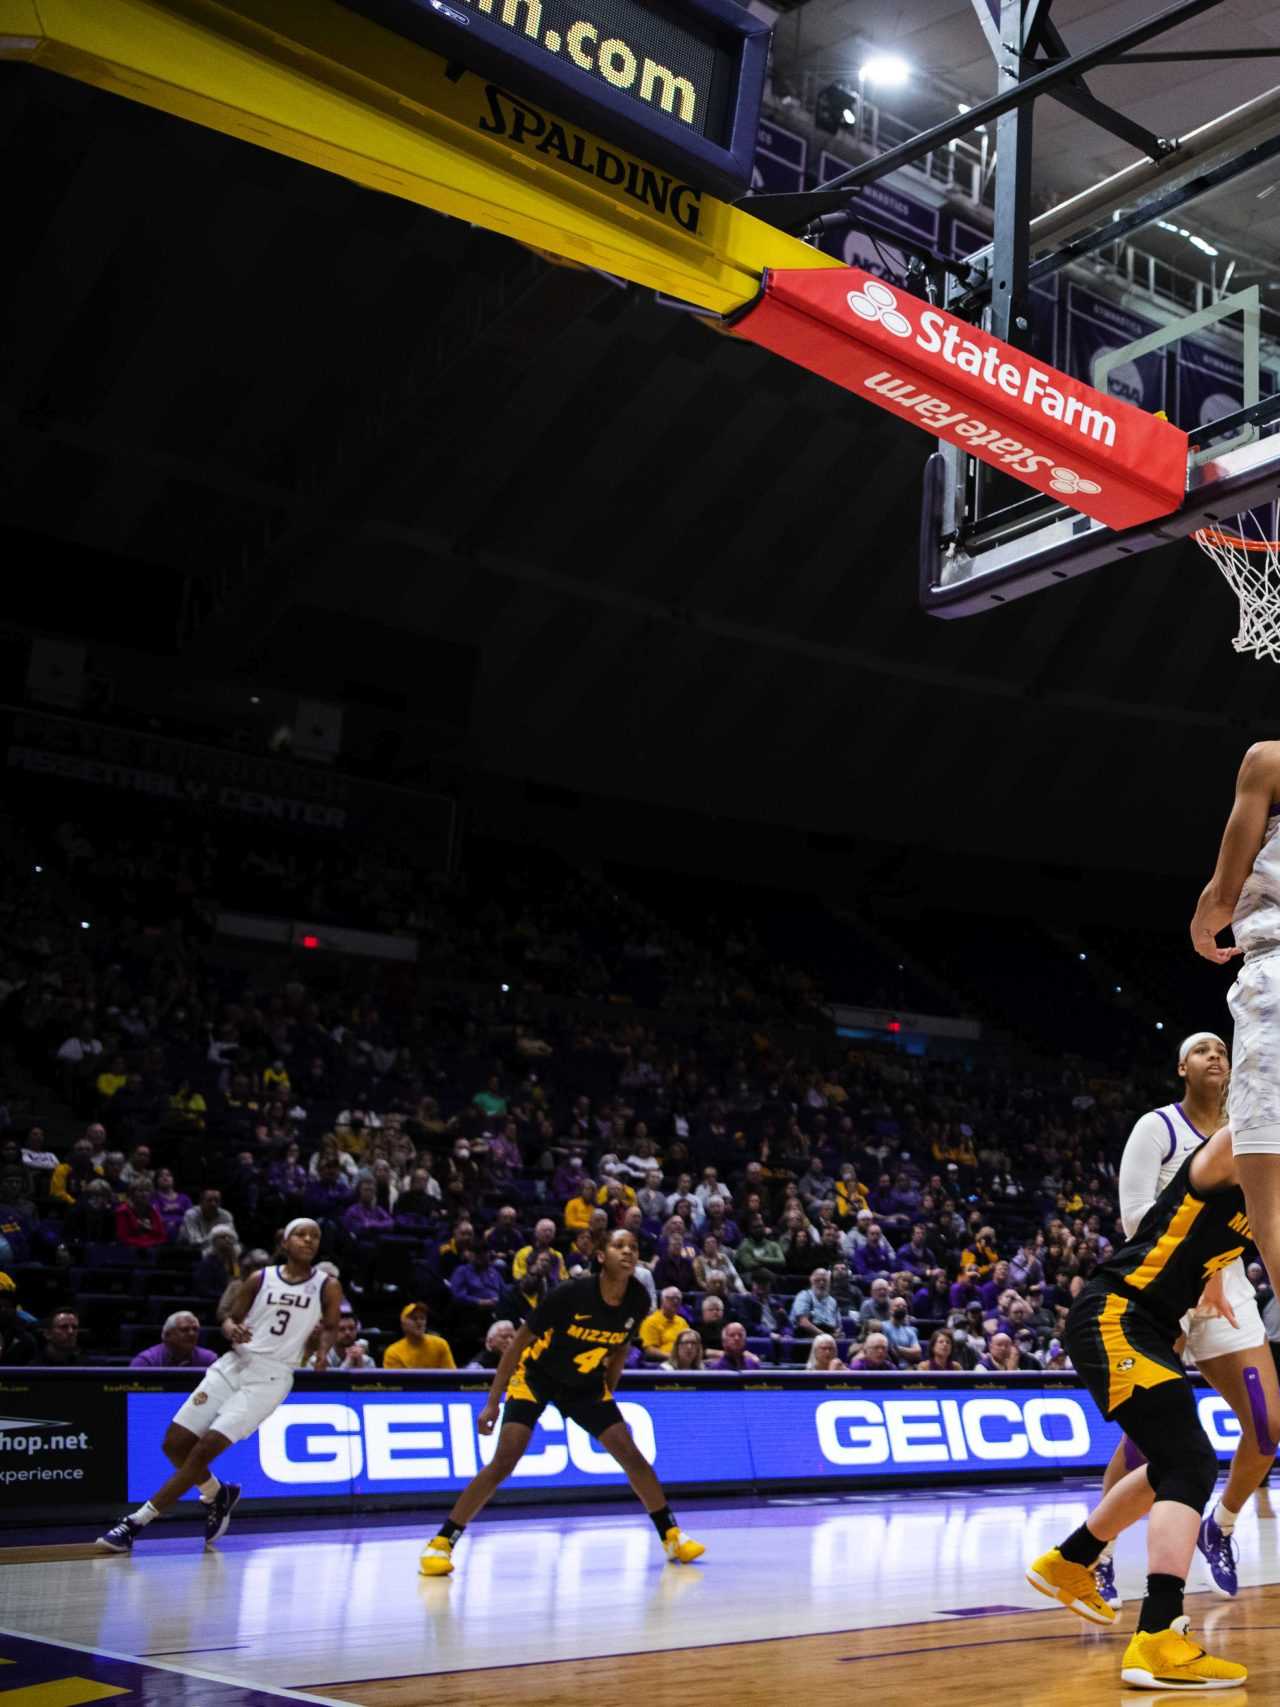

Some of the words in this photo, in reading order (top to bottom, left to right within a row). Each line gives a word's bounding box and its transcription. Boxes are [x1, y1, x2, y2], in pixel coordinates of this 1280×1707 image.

[465, 0, 696, 123] m.com
[480, 84, 701, 232] SPALDING
[267, 1292, 311, 1309] LSU
[270, 1310, 291, 1336] 3
[572, 1346, 609, 1375] 4
[259, 1400, 657, 1484] GEICO
[815, 1398, 1091, 1466] GEICO
